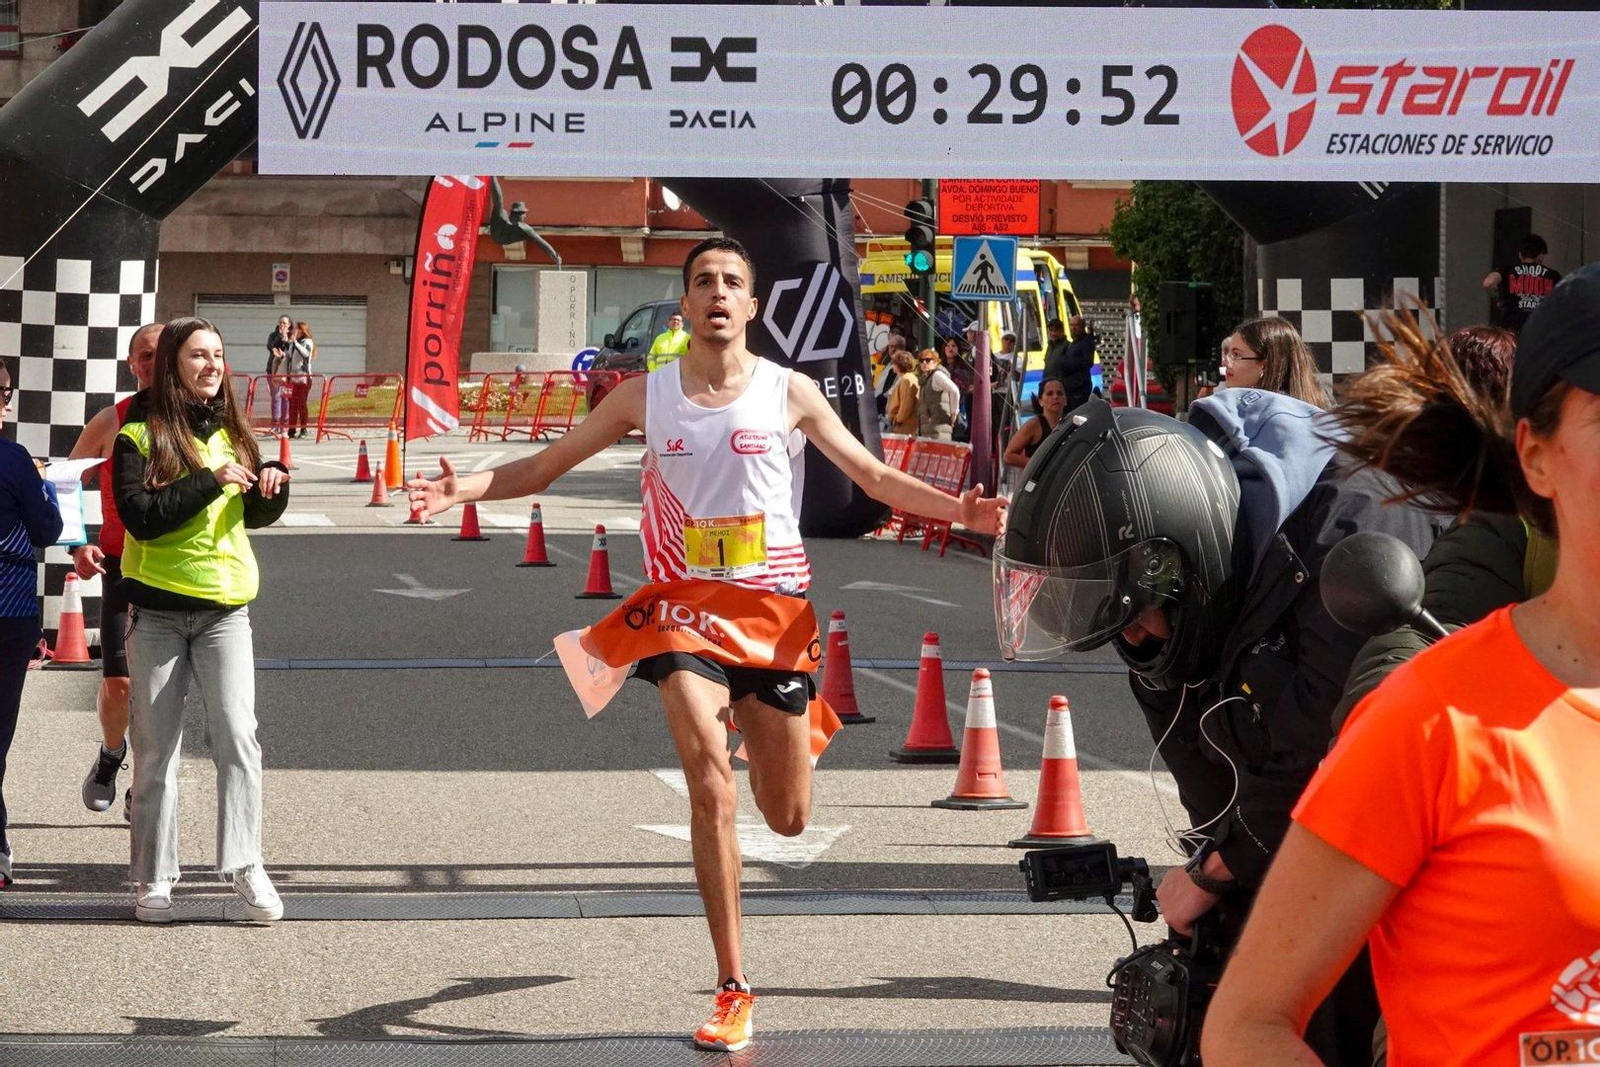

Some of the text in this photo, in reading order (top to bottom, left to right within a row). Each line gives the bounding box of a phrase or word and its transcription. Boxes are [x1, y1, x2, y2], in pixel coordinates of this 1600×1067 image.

[356, 23, 652, 90] RODOSA
[831, 62, 1180, 126] 00:29:52
[1326, 58, 1576, 117] staroil
[425, 111, 585, 133] ALPINE
[669, 109, 757, 129] DACIA
[1326, 133, 1554, 156] ESTACIONES DE SERVICIO
[941, 185, 1038, 194] AVDA. DOMINGO BUENO
[952, 195, 1025, 203] POR ACTIVIDADE
[965, 203, 1014, 212] DEPORTIVA
[986, 214, 1027, 223] PREVISTO
[993, 223, 1009, 232] A52
[1514, 264, 1549, 277] SHOOT
[717, 538, 725, 567] 1
